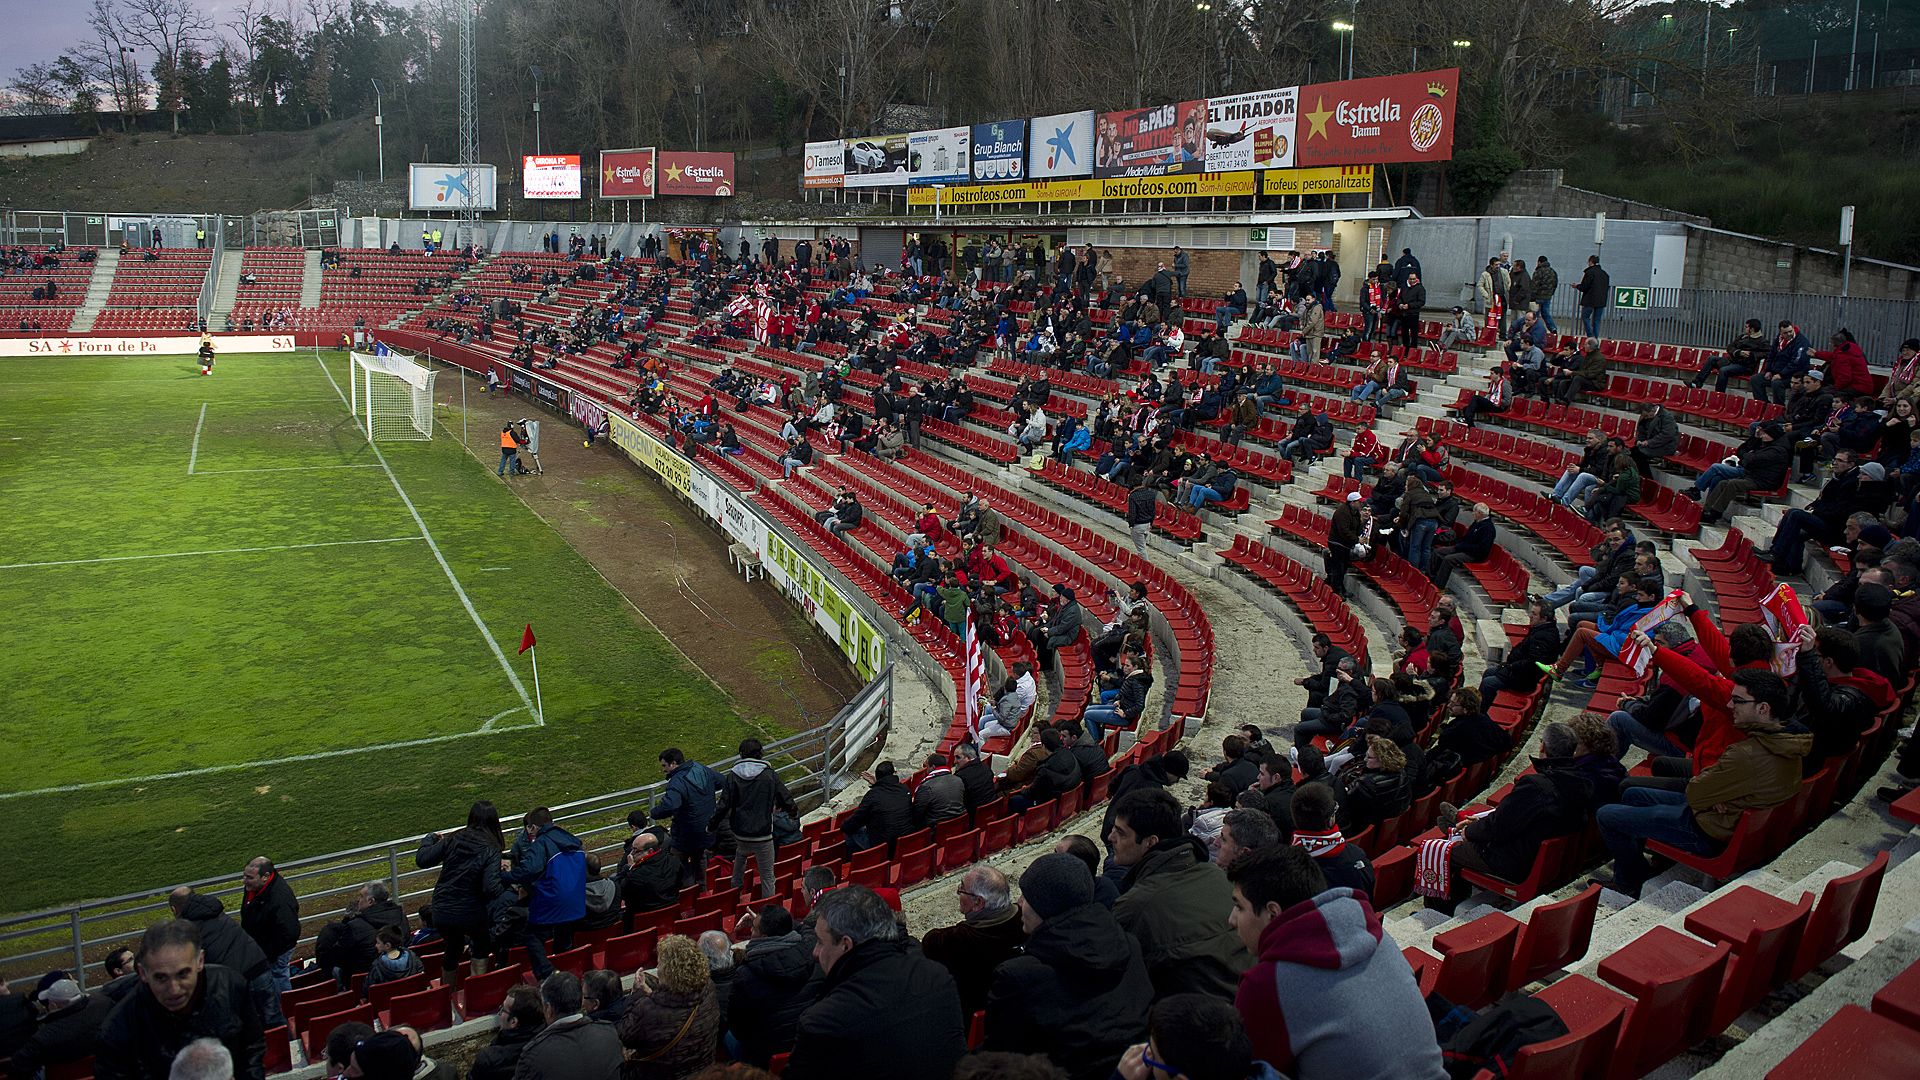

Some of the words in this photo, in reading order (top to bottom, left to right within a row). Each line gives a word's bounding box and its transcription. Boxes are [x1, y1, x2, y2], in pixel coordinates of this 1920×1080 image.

[1208, 108, 1221, 123] EL
[1225, 98, 1294, 121] MIRADOR
[1336, 97, 1400, 126] Estrella
[1125, 119, 1138, 137] NO
[1149, 105, 1175, 131] PAÍS
[1352, 125, 1380, 138] Damm
[974, 143, 992, 157] Grup
[994, 140, 1022, 156] Blanch
[1206, 152, 1221, 161] OBERT
[1222, 151, 1233, 159] TOT
[1234, 149, 1250, 158] L'ANY
[535, 157, 558, 165] GIRONA
[815, 152, 843, 167] Tamesol
[615, 166, 640, 178] Estrella
[685, 164, 724, 177] Estrella
[1102, 178, 1197, 197] lostrofeos.com
[1200, 182, 1224, 193] Som-hi
[1265, 178, 1297, 191] Trofeus
[1302, 176, 1371, 193] personalitzats
[951, 187, 1026, 203] lostrofeos.com
[29, 340, 52, 352] SA
[78, 341, 113, 352] Forn
[118, 341, 135, 352] de
[140, 341, 156, 351] Pa
[272, 338, 293, 349] SA
[615, 424, 654, 458] PHOENIX
[655, 457, 665, 475] 972
[665, 465, 673, 479] 20
[674, 471, 681, 486] 99
[683, 477, 691, 493] 65
[818, 580, 824, 607] 9
[840, 611, 849, 645] EL
[848, 611, 858, 665] 9
[861, 634, 870, 671] EL
[870, 635, 881, 680] 9
